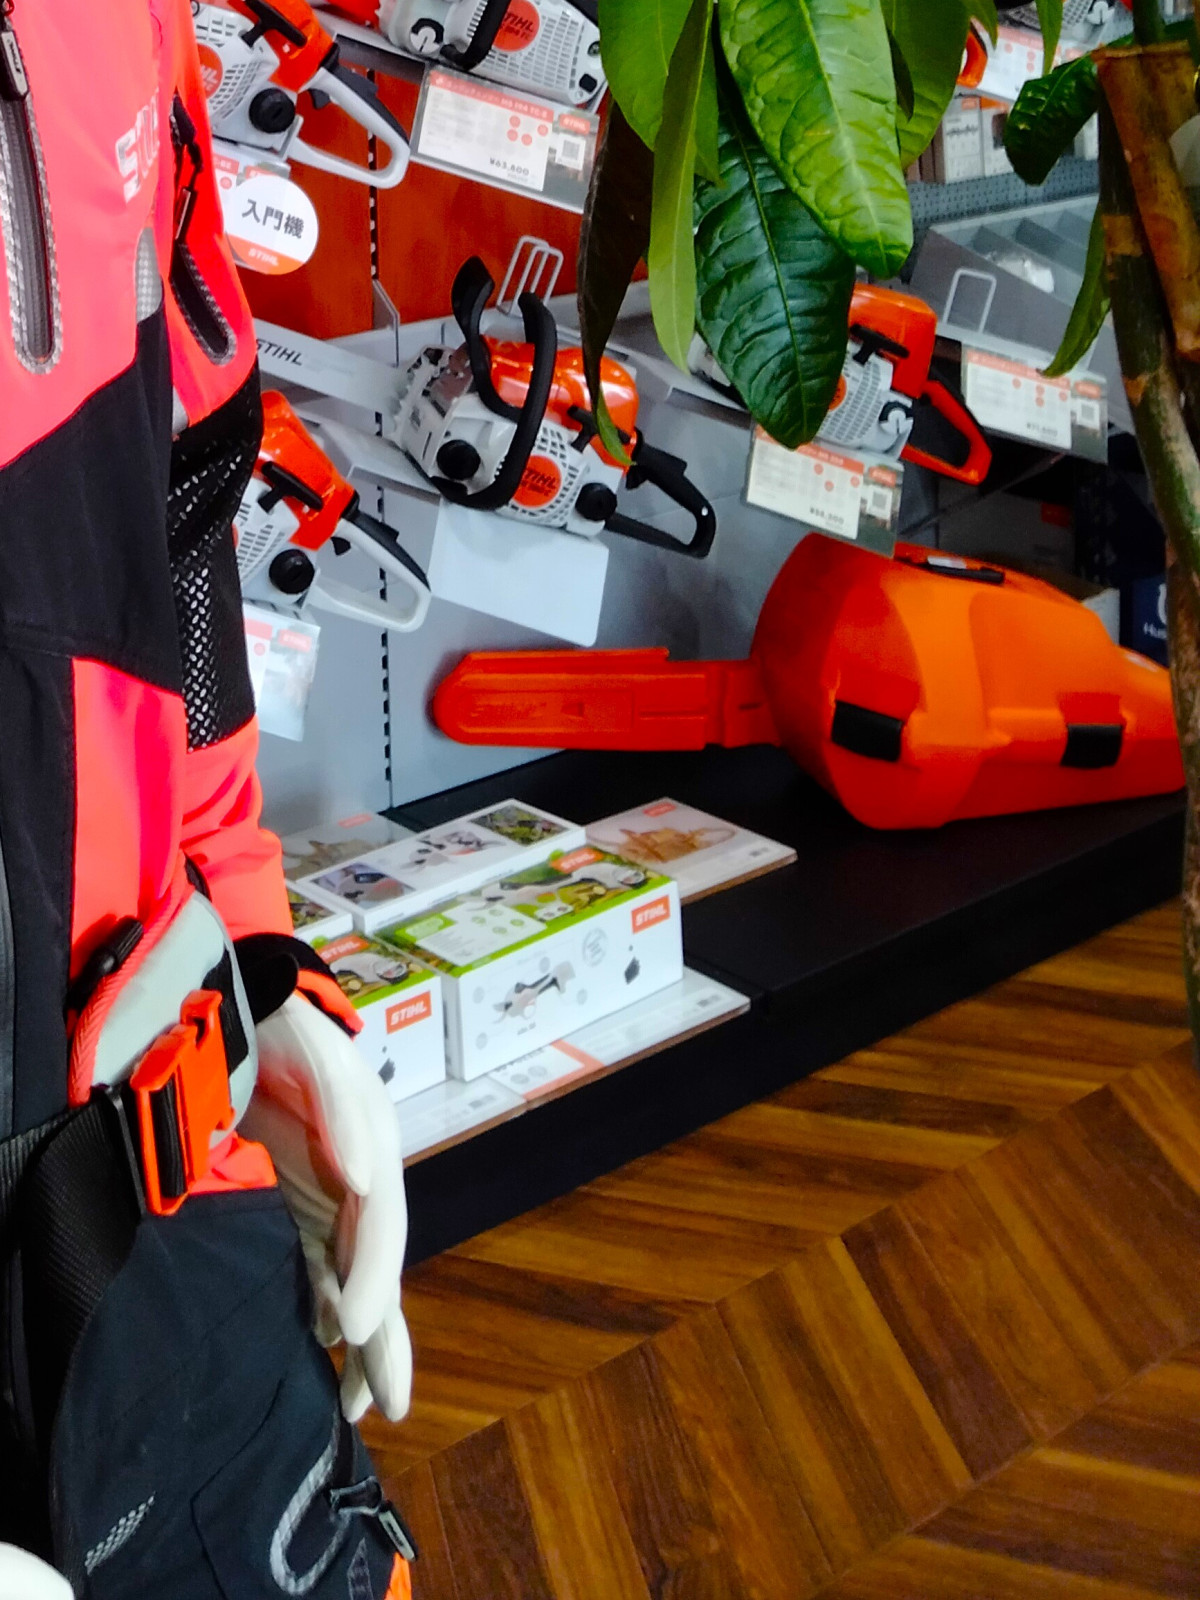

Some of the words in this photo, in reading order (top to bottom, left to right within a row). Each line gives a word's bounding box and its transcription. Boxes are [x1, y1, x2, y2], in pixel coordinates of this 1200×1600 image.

[503, 11, 536, 32] TIHL
[241, 198, 305, 239] 入門機
[522, 467, 558, 489] TIHL
[635, 903, 667, 927] STIHL
[390, 1000, 428, 1026] STIHL
